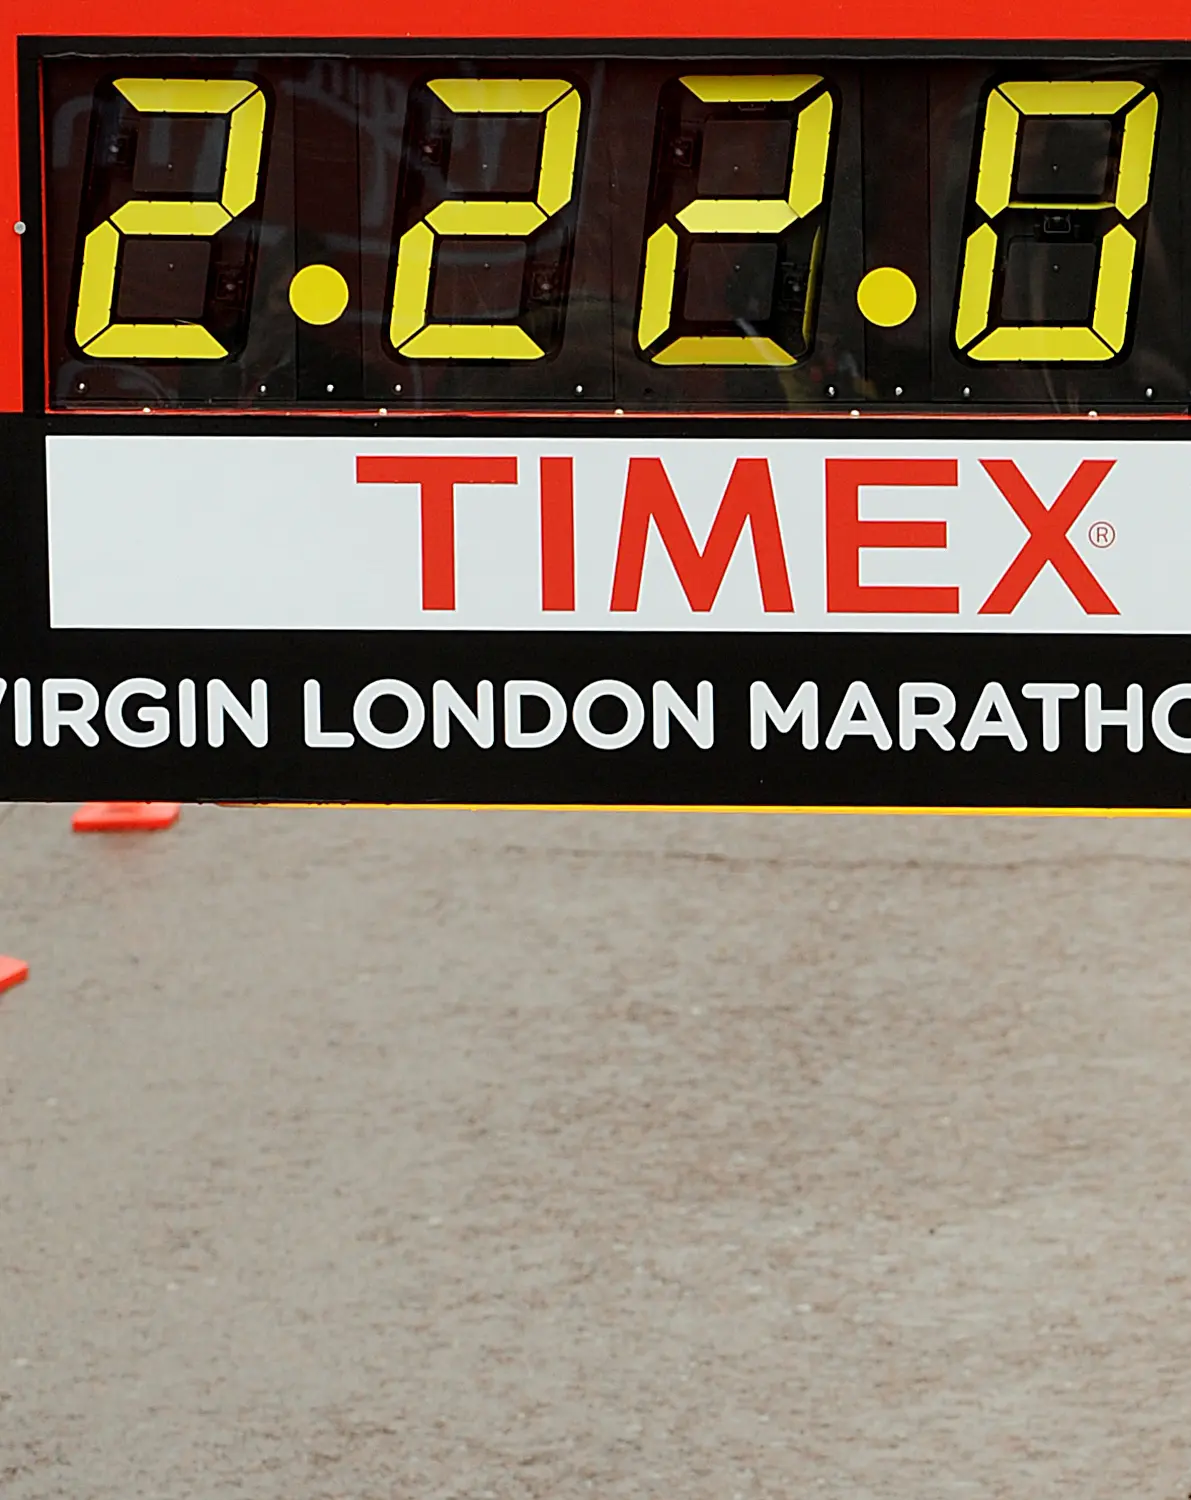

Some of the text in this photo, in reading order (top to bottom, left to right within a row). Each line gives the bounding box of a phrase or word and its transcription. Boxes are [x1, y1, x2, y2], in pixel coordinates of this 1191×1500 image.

[355, 455, 1122, 616] TIMEX
[0, 677, 268, 748] IRGIN
[303, 679, 714, 749] LONDON
